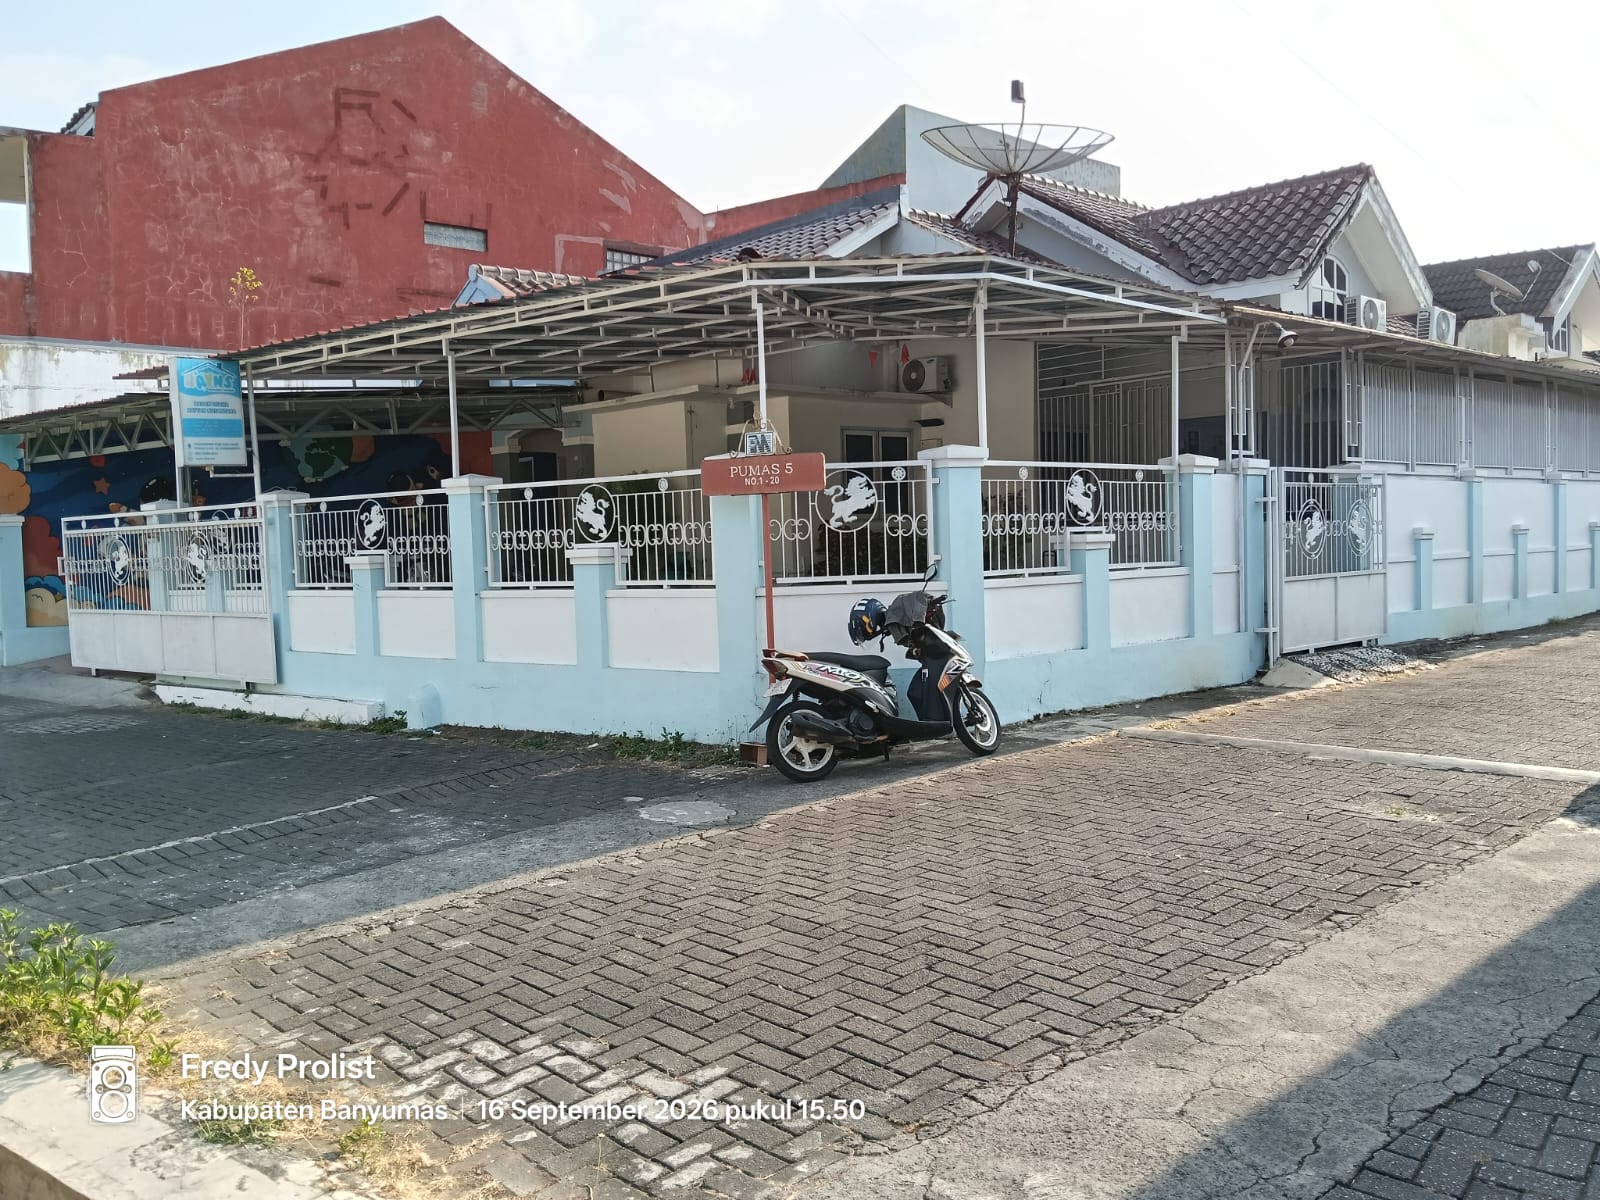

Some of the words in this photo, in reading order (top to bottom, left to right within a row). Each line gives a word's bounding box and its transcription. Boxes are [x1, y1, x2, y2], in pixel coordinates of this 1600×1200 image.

[730, 464, 780, 477] PUMAS
[785, 463, 793, 474] 5
[770, 476, 779, 484] 20
